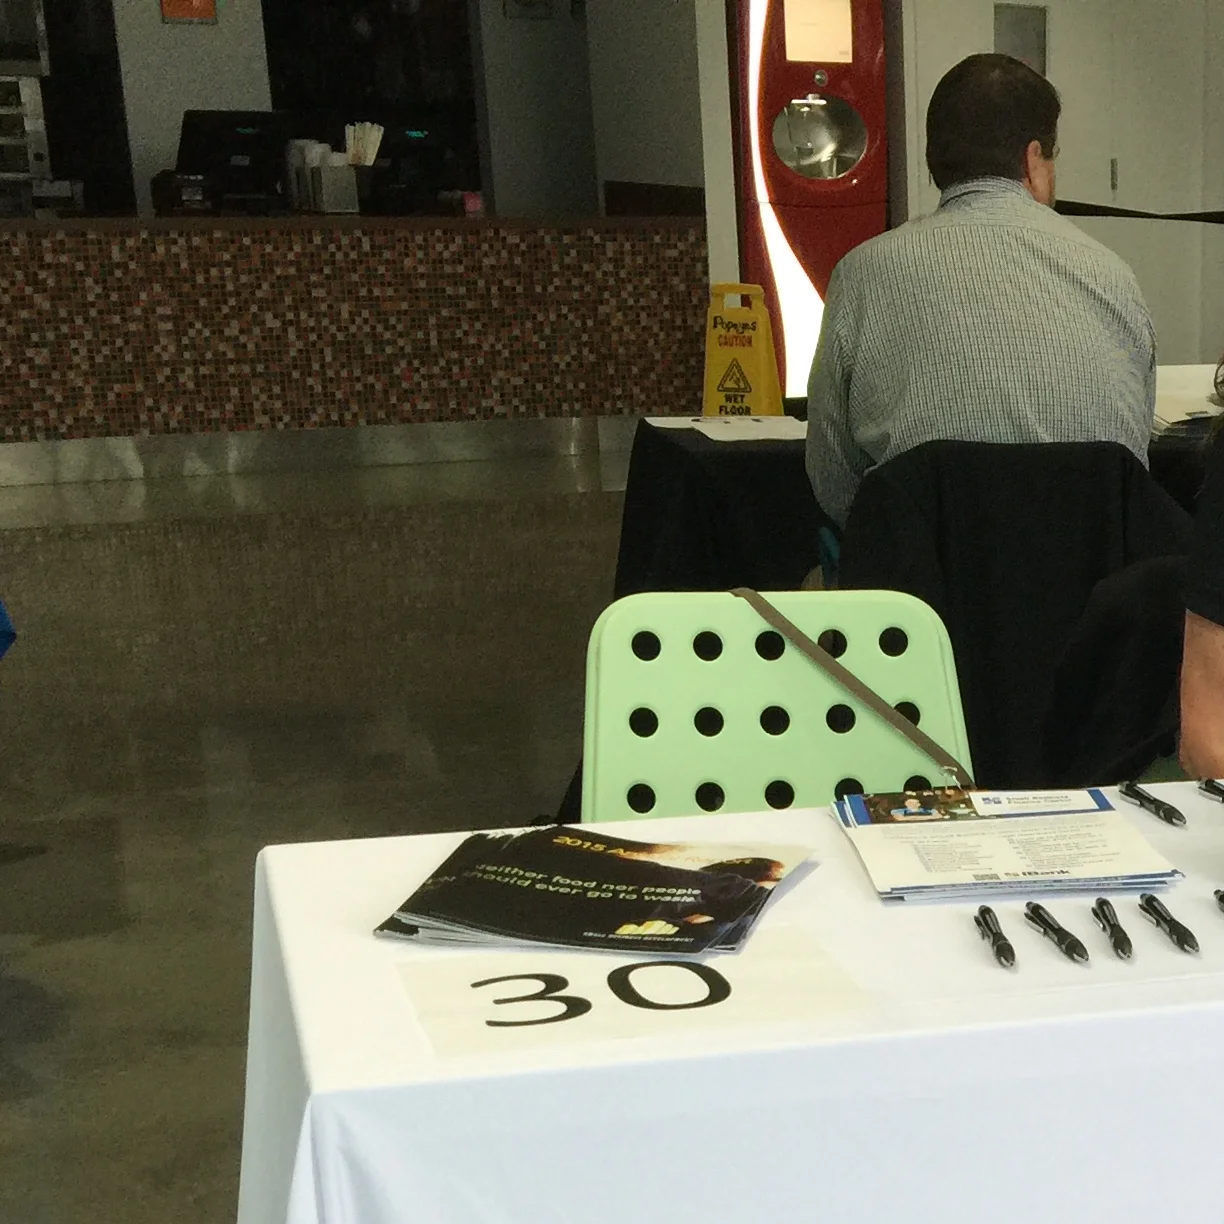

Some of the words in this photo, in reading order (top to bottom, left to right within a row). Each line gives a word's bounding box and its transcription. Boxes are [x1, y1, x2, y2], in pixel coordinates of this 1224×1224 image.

[713, 315, 757, 335] Popeyes
[718, 334, 753, 348] CAUTION
[725, 393, 745, 404] WET
[719, 405, 752, 415] FLOOR
[553, 836, 607, 853] 2015
[535, 883, 583, 895] ever
[587, 891, 613, 899] go
[619, 892, 638, 900] to
[552, 875, 597, 888] food
[602, 883, 639, 892] nor
[642, 887, 701, 896] people
[470, 960, 732, 1028] 30
